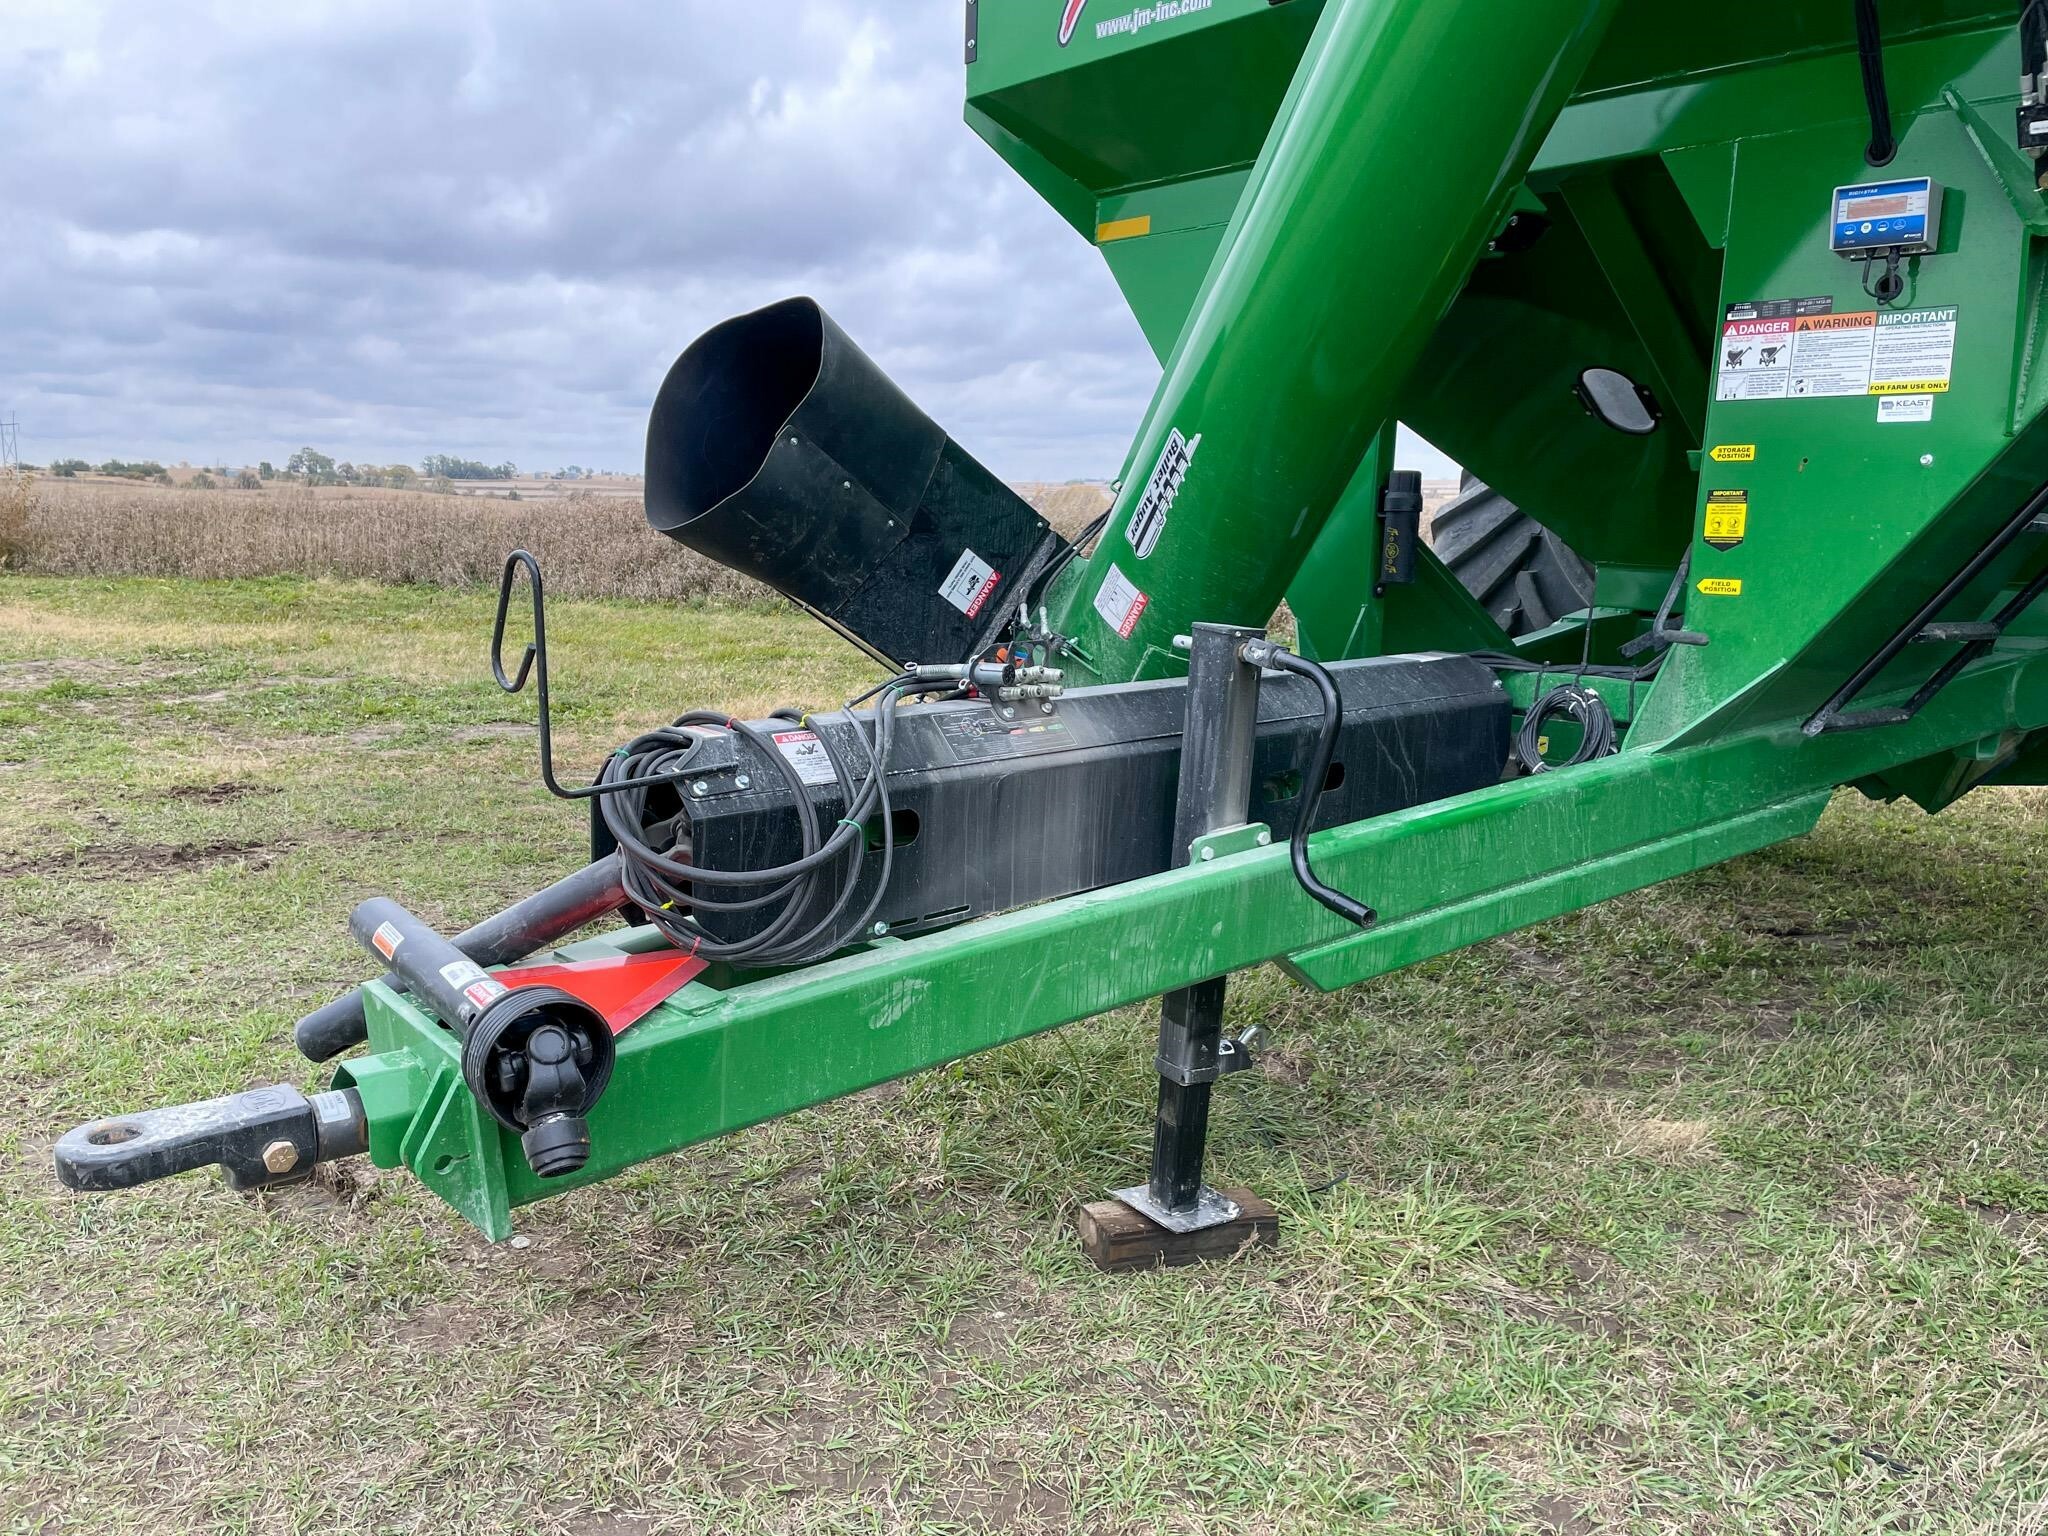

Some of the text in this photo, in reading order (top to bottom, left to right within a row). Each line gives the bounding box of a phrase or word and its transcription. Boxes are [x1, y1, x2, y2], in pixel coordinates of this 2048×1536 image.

[1096, 0, 1212, 39] www.jm-inc.com
[1739, 321, 1790, 335] DANGER
[1813, 316, 1872, 330] WARNING
[1878, 309, 1956, 326] IMPORTANT
[1131, 437, 1179, 540] Bullet Auger
[967, 582, 995, 617] DANGER
[1120, 602, 1142, 639] DANGER
